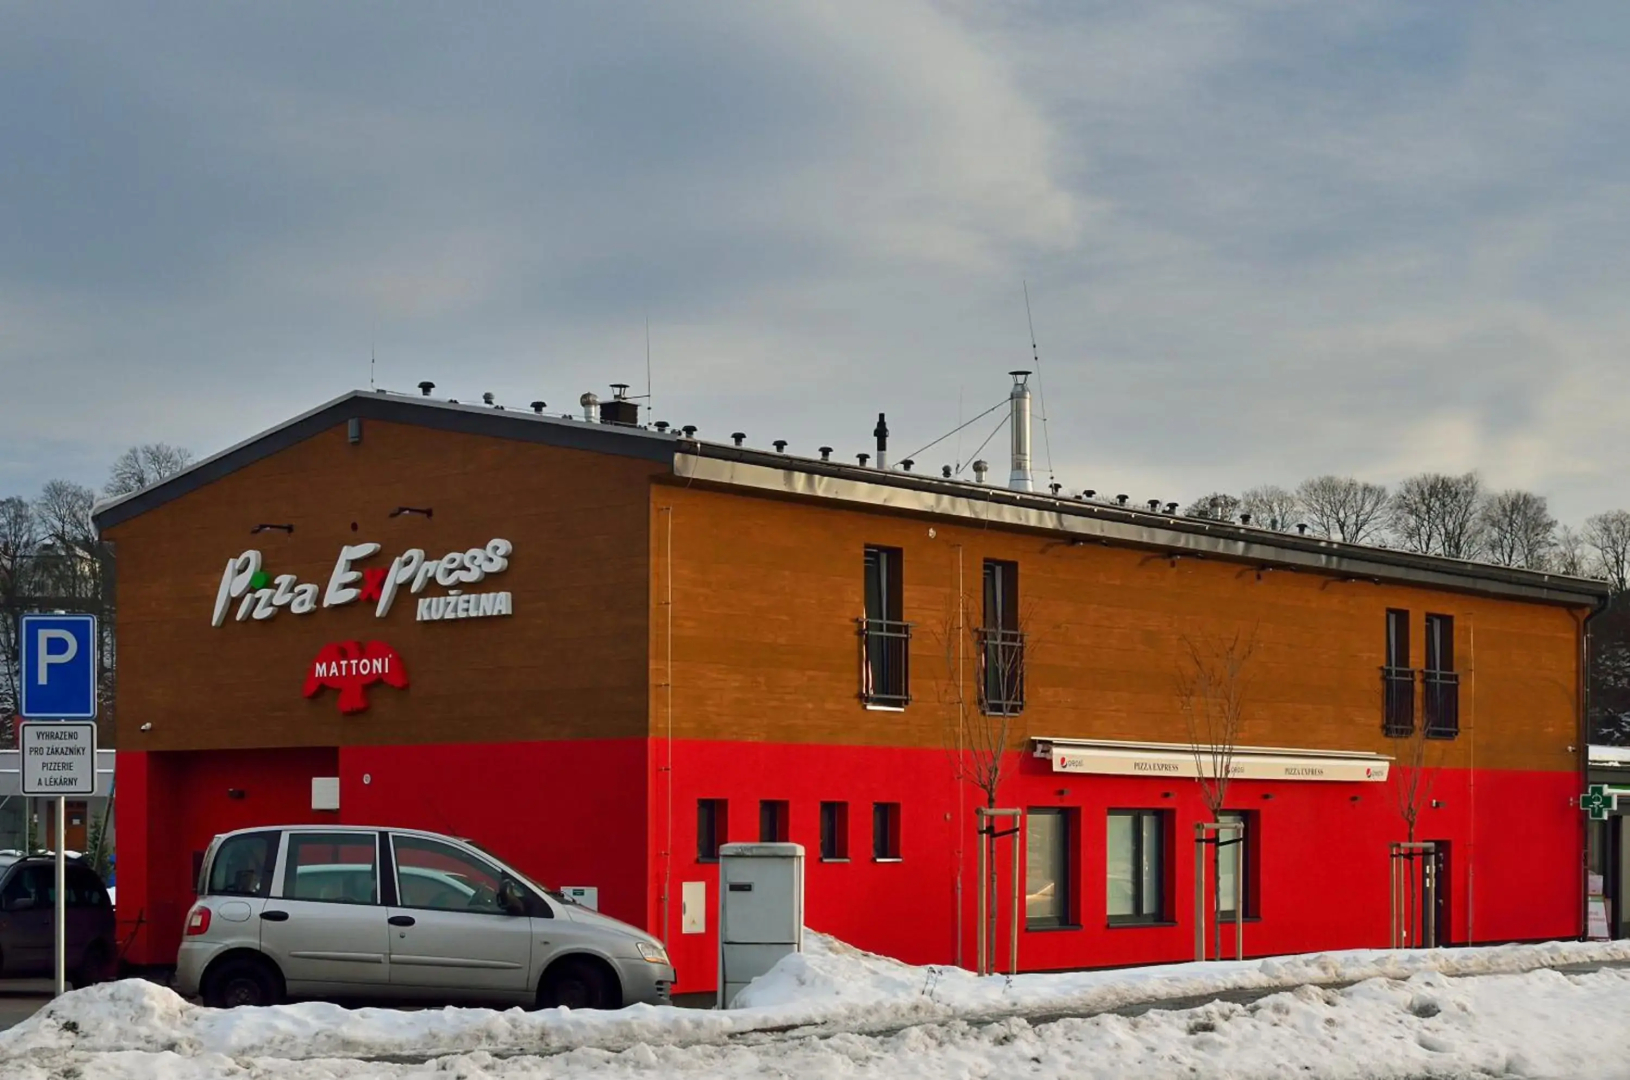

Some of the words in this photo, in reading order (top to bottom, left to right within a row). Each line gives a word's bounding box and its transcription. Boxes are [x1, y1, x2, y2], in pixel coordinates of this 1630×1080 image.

[211, 549, 319, 627] Pizza
[416, 590, 512, 621] KUŽELNA
[37, 628, 78, 685] P
[315, 657, 389, 677] MATTONI
[36, 731, 78, 740] VYHRAZENO
[29, 747, 44, 755] PRO
[46, 745, 86, 755] ZÁKAZNÍKY
[41, 762, 74, 771] PIZZERIE
[1133, 762, 1152, 770] PIZZA
[1152, 763, 1179, 772] EXPRESS
[37, 777, 42, 786] A
[44, 775, 78, 786] LÉKÁRNY
